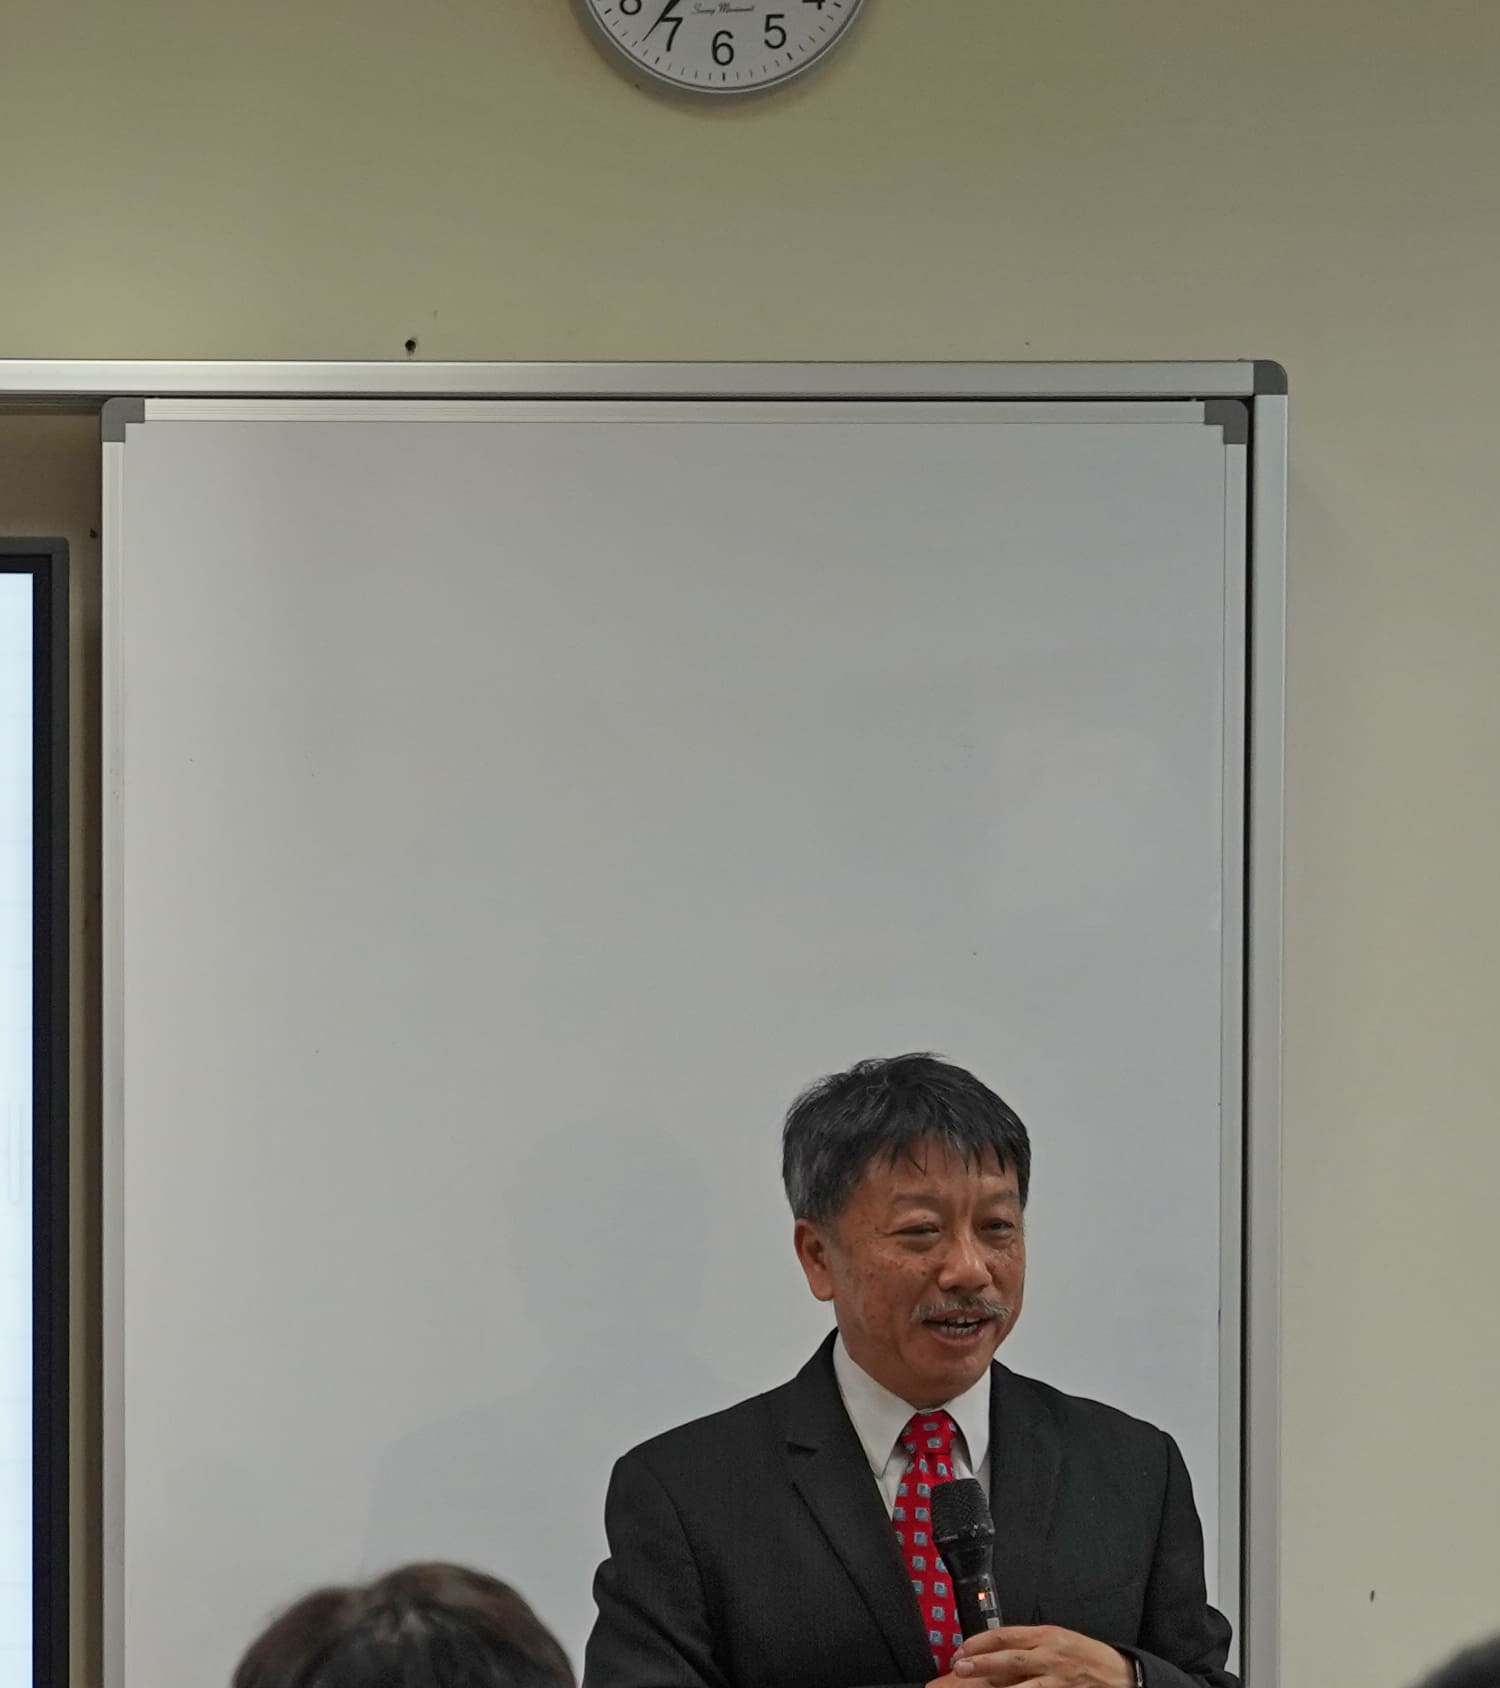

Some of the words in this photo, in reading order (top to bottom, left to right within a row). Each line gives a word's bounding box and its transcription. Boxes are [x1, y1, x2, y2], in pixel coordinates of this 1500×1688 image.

[659, 16, 684, 52] 7
[711, 30, 735, 66] 6
[763, 13, 787, 49] 5
